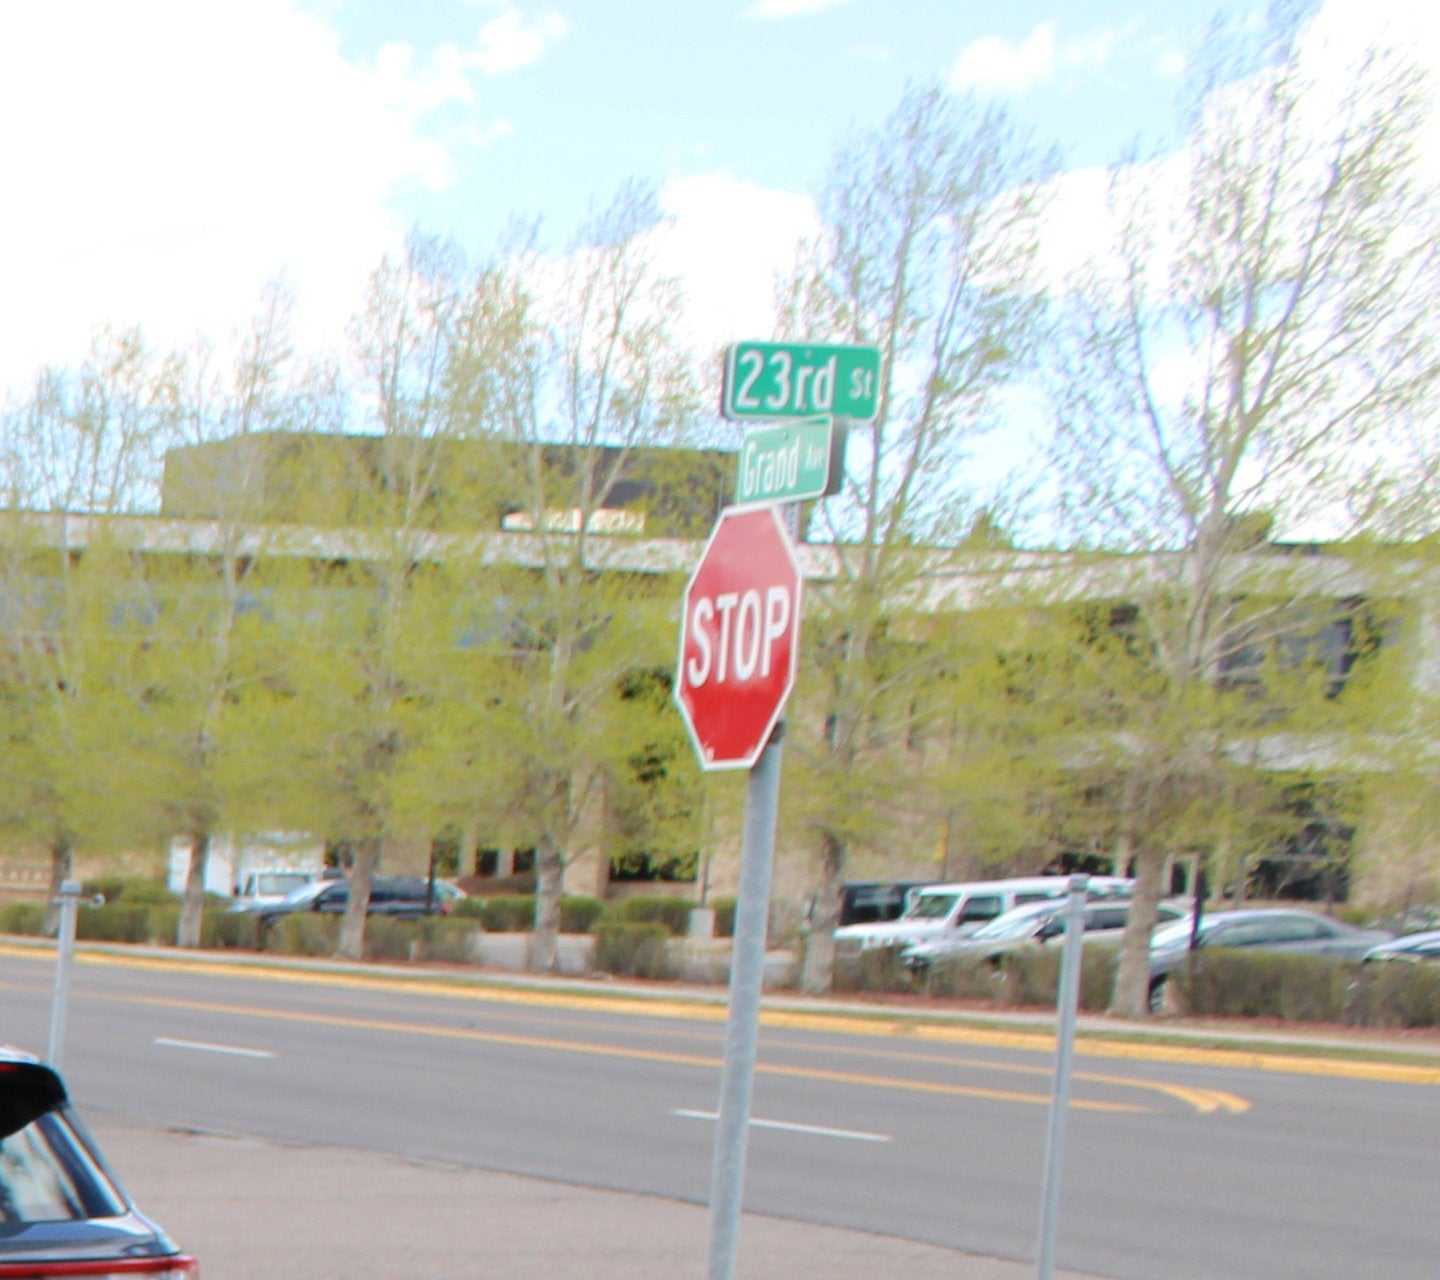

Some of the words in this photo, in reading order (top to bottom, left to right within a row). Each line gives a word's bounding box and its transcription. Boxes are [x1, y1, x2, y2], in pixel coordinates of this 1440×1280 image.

[737, 351, 837, 410] 23rd
[849, 367, 873, 399] St
[744, 434, 801, 497] Grand
[688, 585, 790, 688] STOP
